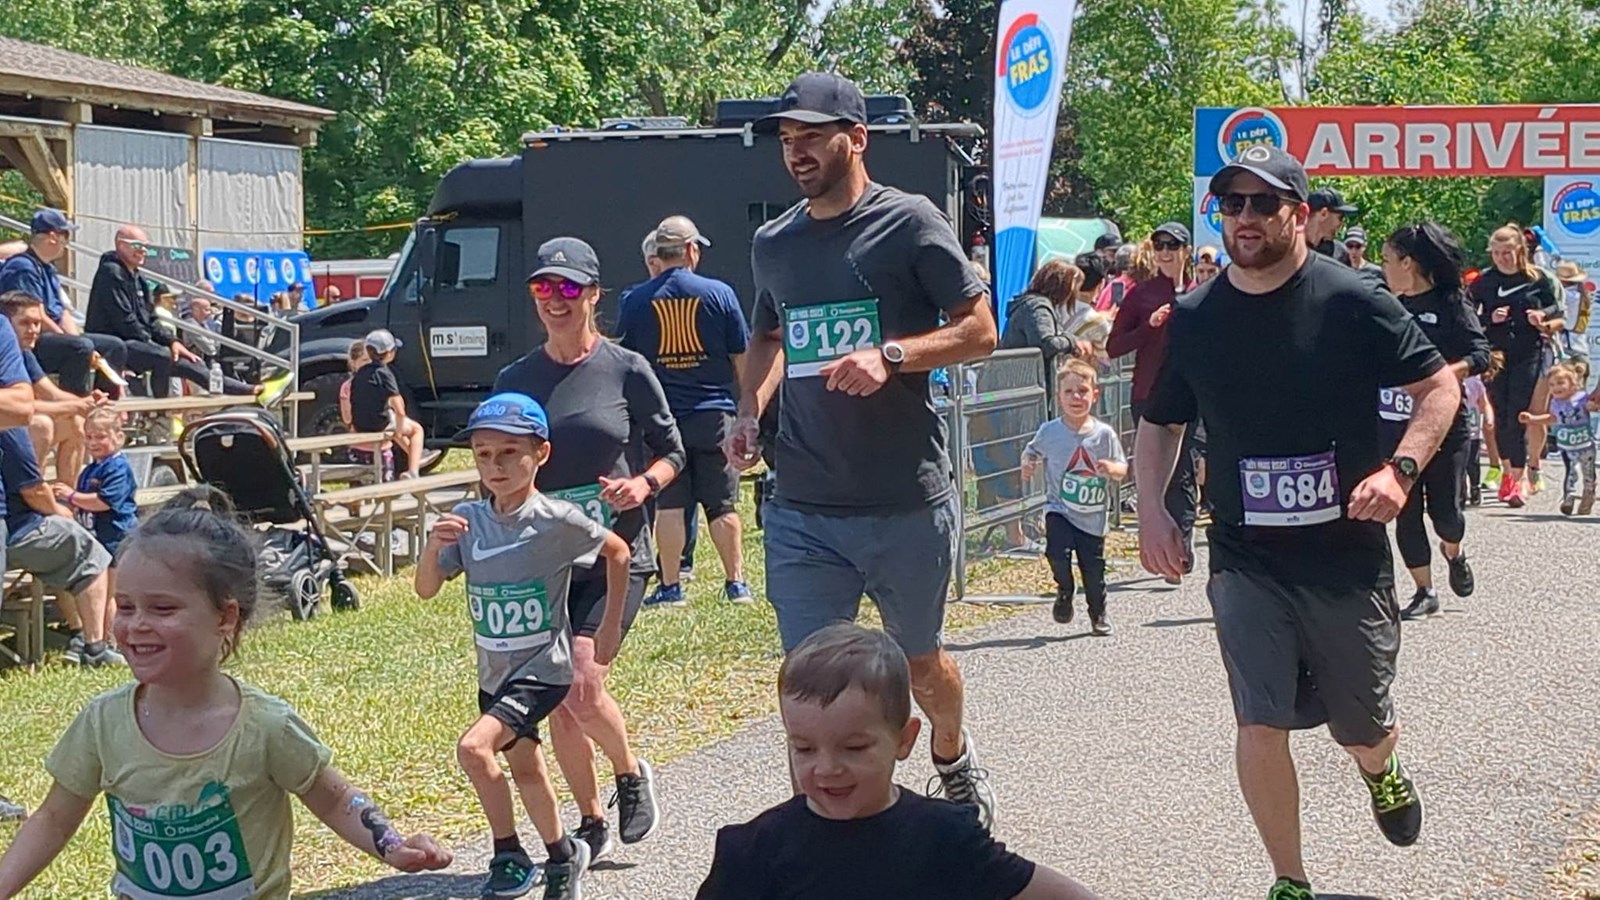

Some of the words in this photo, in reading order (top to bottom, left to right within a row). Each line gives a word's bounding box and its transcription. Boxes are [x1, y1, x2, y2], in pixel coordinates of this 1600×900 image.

[1009, 49, 1049, 89] FRAS
[1010, 45, 1021, 61] LE
[1303, 108, 1600, 169] ARRIVÉE
[1563, 206, 1600, 225] FRAS
[1564, 202, 1574, 210] LE
[815, 317, 874, 357] 122
[1277, 469, 1335, 509] 684
[487, 598, 544, 635] 029
[143, 831, 238, 890] 003
